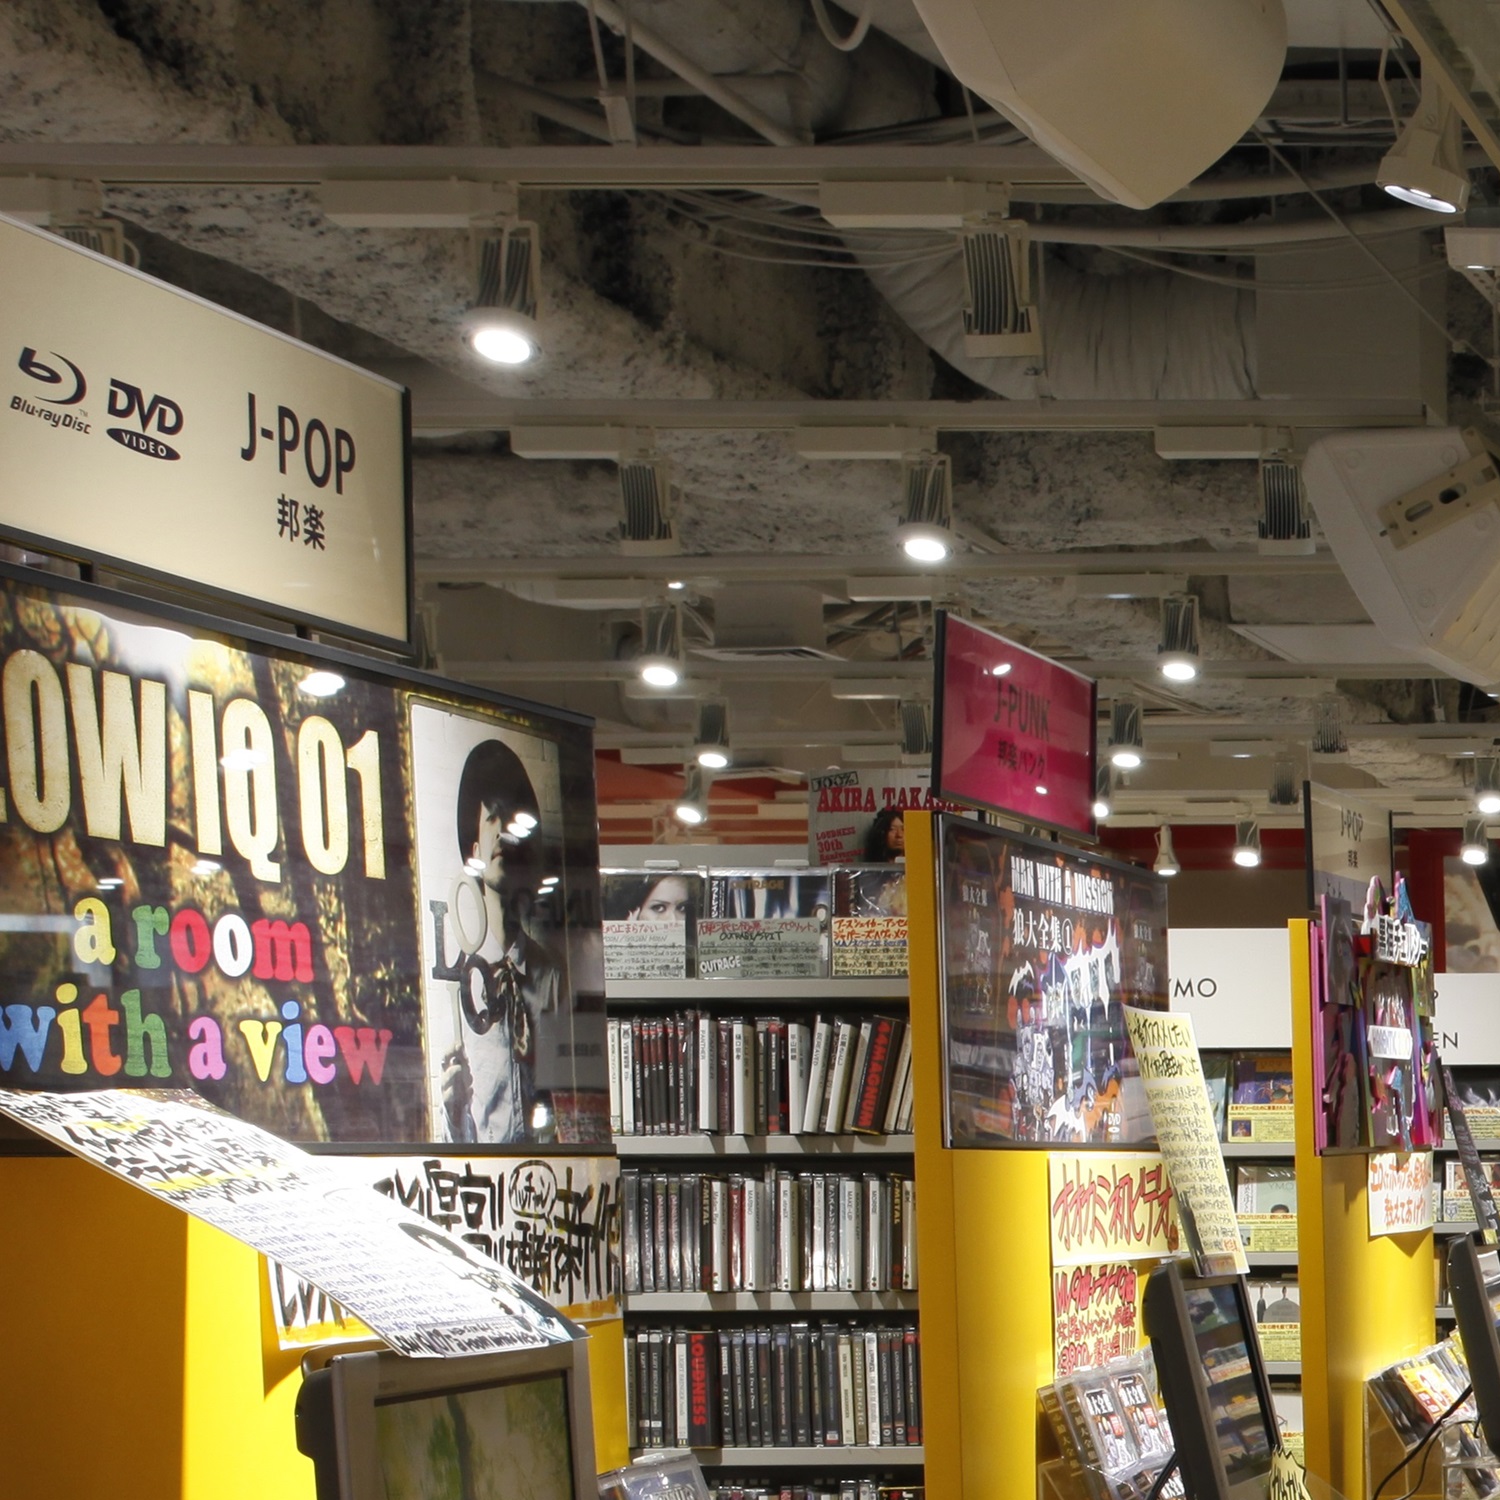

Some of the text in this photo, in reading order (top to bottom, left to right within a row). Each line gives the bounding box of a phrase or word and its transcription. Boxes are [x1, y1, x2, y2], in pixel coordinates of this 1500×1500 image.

[11, 397, 91, 435] Blu-ray Disc
[107, 379, 184, 436] DVD
[121, 432, 168, 458] VIDEO
[240, 392, 356, 495] J-POP
[276, 493, 326, 551] 邦楽
[0, 649, 386, 884] OW IQ 01
[817, 787, 877, 812] AKIRA
[816, 826, 856, 840] LOUDNESS
[818, 839, 843, 853] 30th
[1340, 809, 1364, 843] J-POP
[1011, 856, 1114, 916] MAN WITH A MISSION
[73, 897, 316, 983] a room
[700, 955, 742, 974] OUTRAGE
[0, 982, 393, 1086] with a view
[699, 1029, 707, 1060] PANTHER
[857, 1021, 892, 1129] 44MAGNUM
[701, 1178, 711, 1225] J-METAL
[690, 1334, 706, 1426] LOUDNESS
